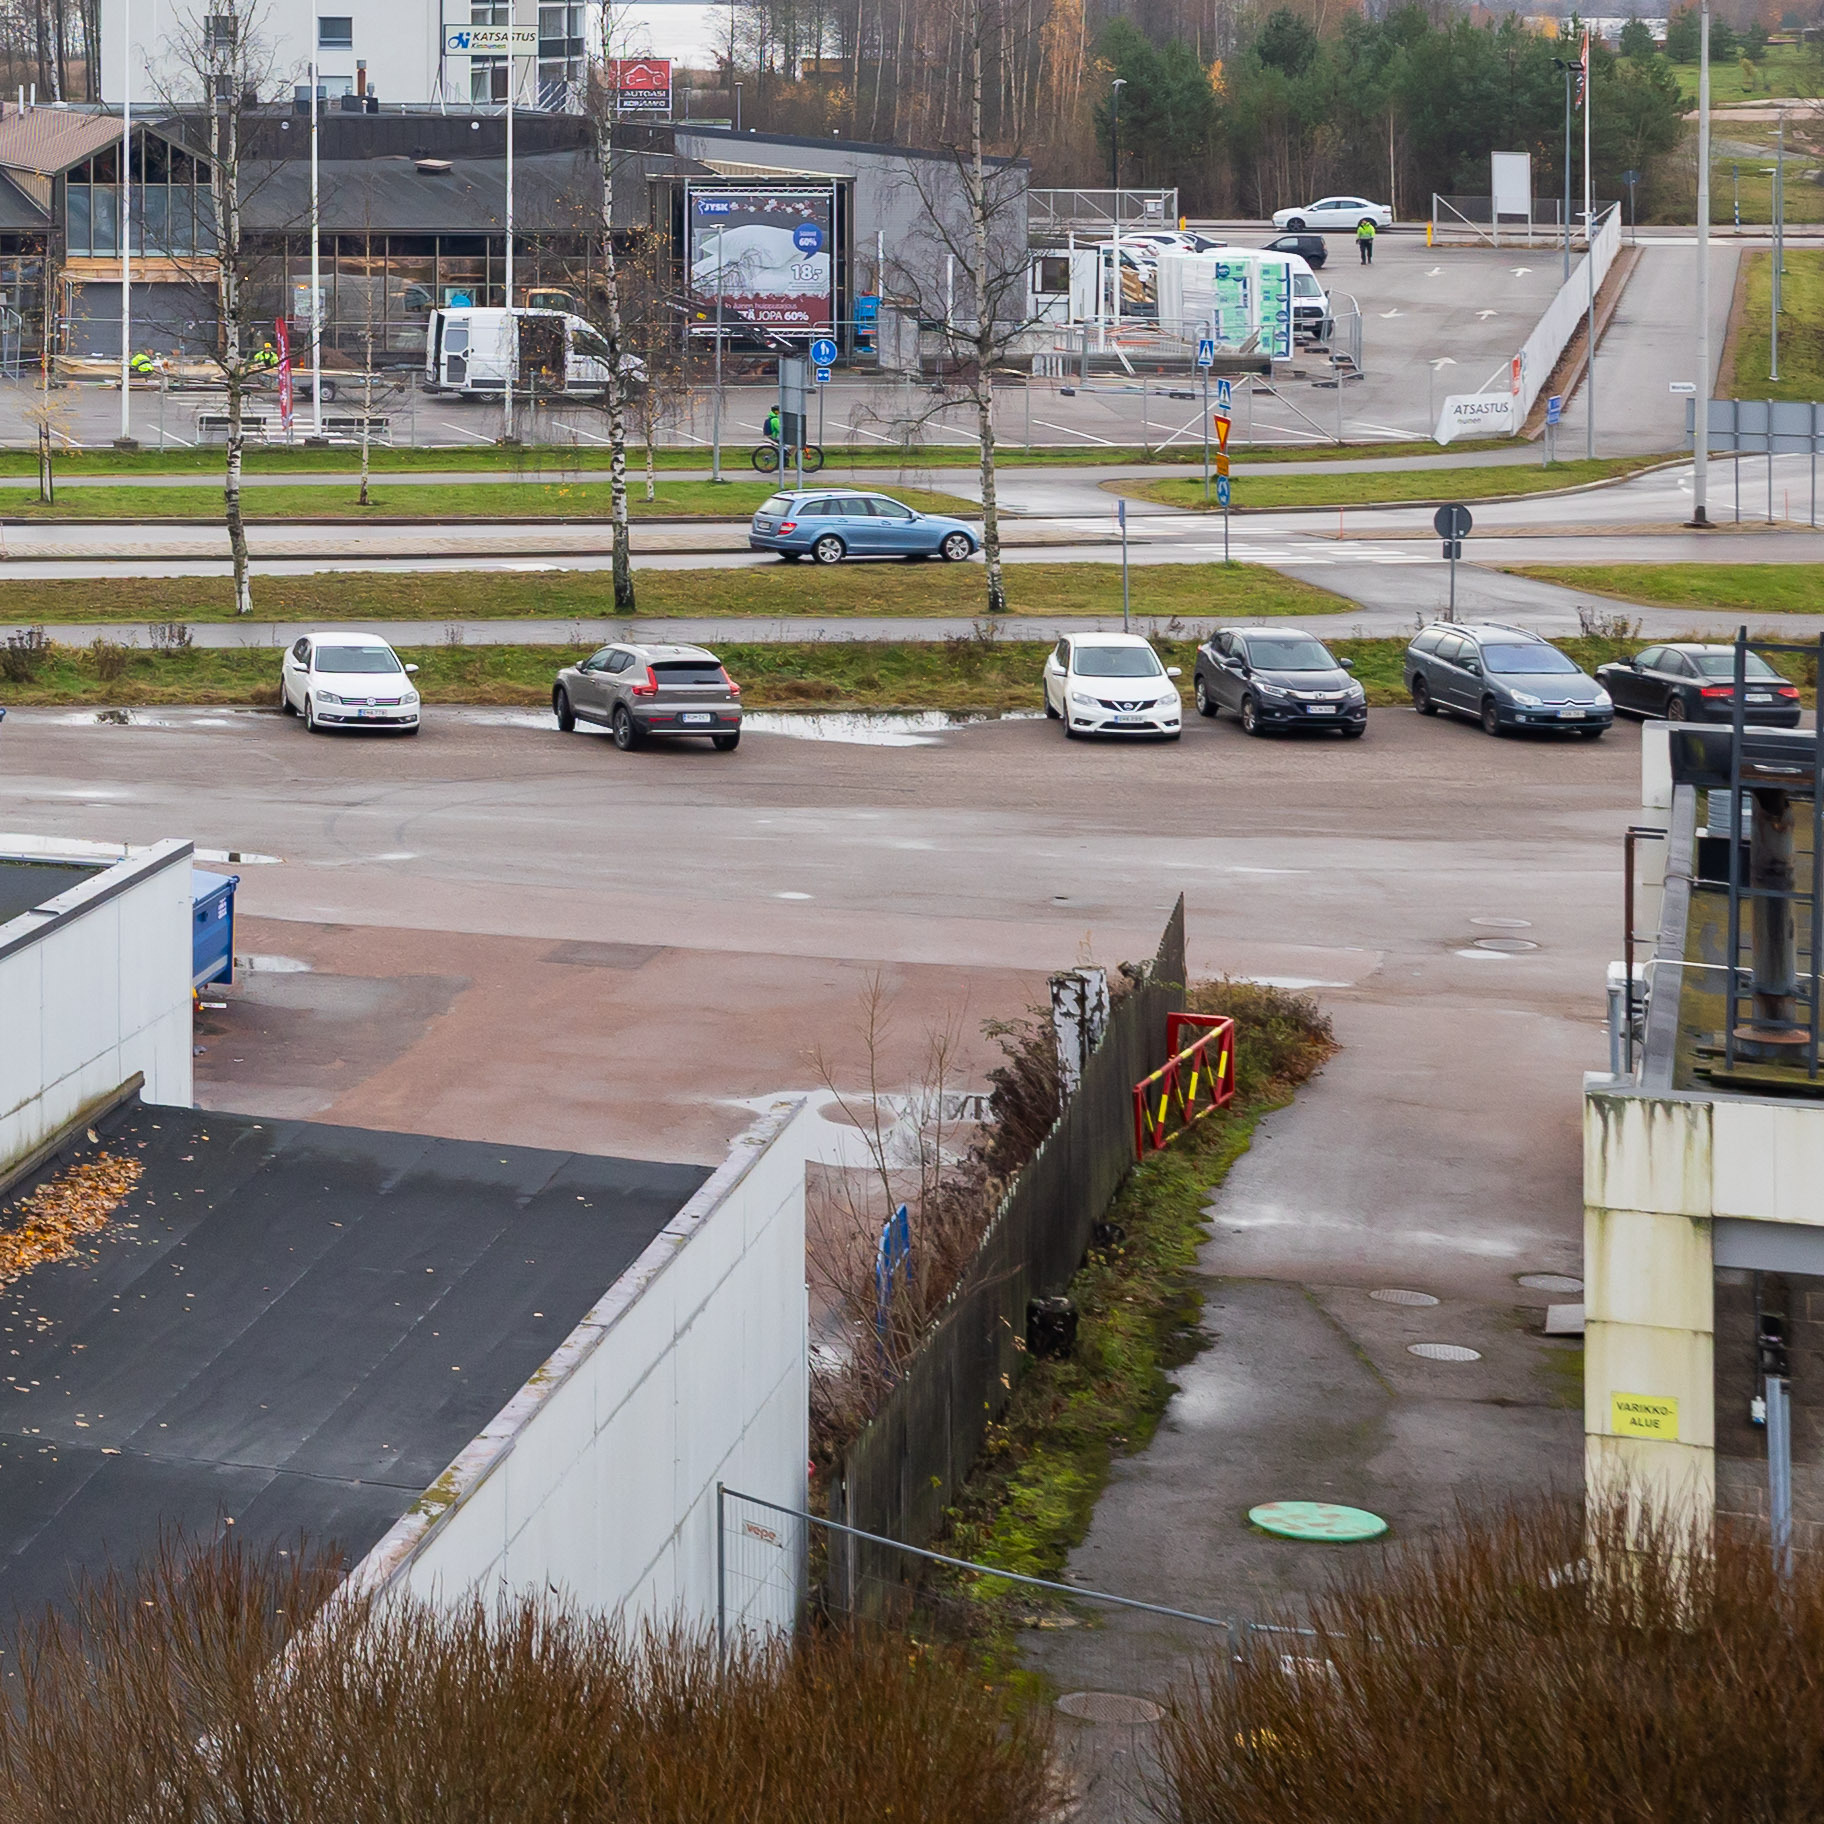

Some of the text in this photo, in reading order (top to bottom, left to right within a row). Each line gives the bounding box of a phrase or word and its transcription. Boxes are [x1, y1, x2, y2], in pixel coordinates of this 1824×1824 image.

[472, 32, 536, 42] KATSASTUS
[704, 203, 728, 212] JYSK
[799, 237, 817, 246] 60%
[757, 311, 783, 320] JOPA
[784, 311, 810, 321] 60%
[1451, 402, 1509, 414] ATSASTUS
[1616, 1401, 1674, 1416] VARIKKO-
[1629, 1417, 1661, 1429] ALUE
